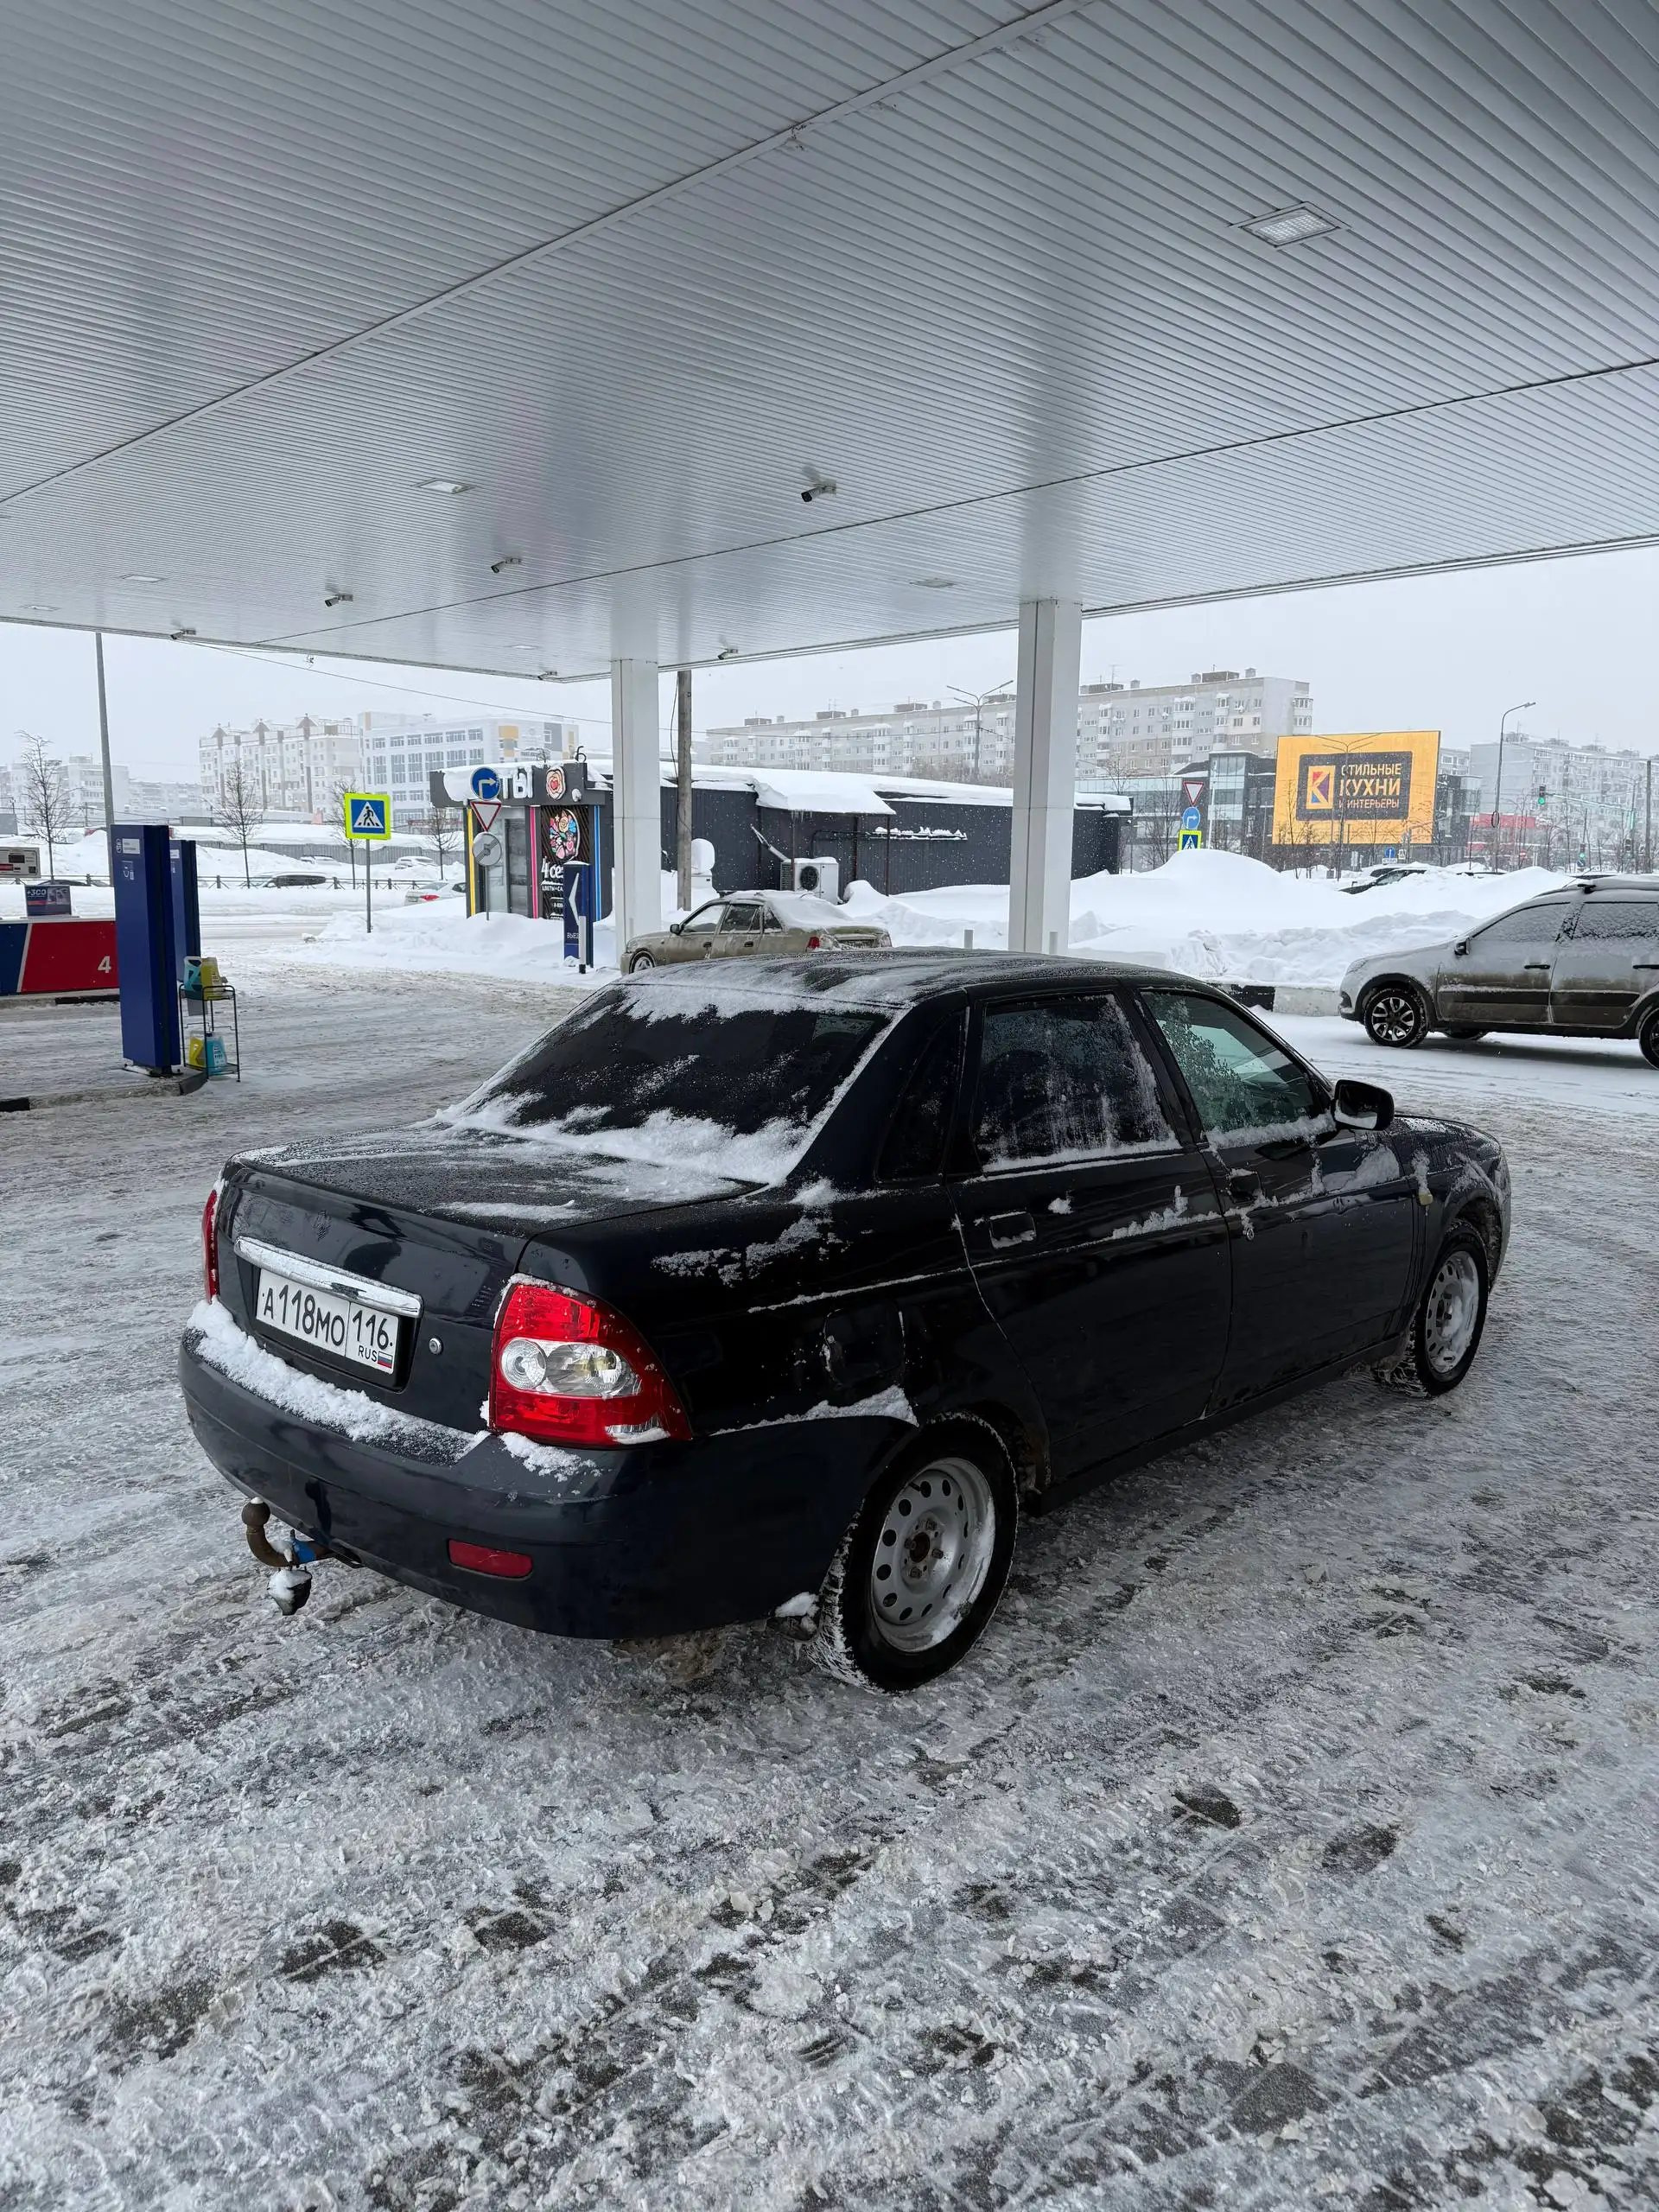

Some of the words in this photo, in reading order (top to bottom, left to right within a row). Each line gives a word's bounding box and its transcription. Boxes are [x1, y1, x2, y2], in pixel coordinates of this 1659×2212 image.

[1340, 763, 1402, 776] СТИЛЬНЫЕ
[1339, 778, 1401, 796] КУХНИ
[1347, 798, 1400, 810] ИНТЕРЬЕРЫ
[97, 956, 111, 974] 4
[264, 1284, 346, 1347] А118МО
[352, 1310, 390, 1351] 116
[358, 1344, 378, 1363] RUS
